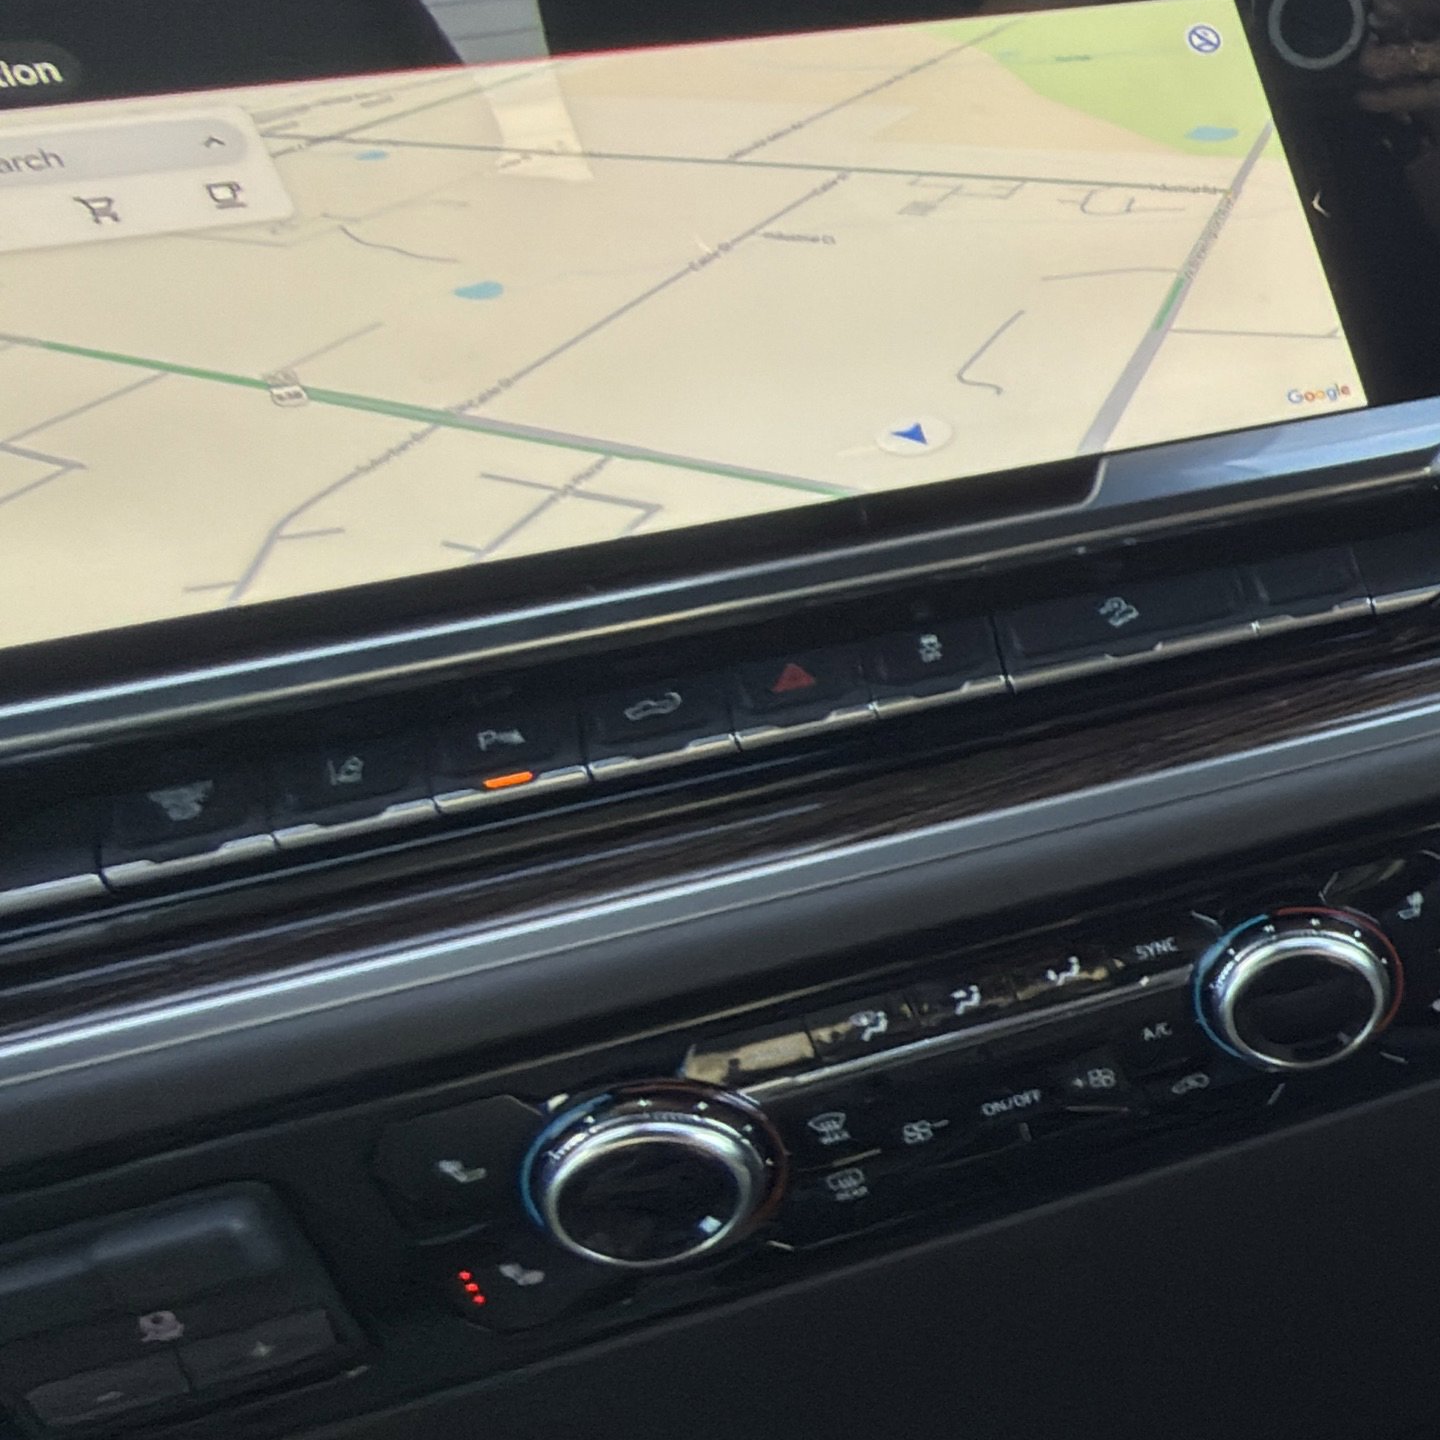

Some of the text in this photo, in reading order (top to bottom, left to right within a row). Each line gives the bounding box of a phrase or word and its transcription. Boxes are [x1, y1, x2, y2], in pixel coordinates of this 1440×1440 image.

[1286, 383, 1351, 406] Google
[1135, 936, 1179, 961] SYNC
[1141, 1021, 1173, 1042] A/C
[980, 1087, 1043, 1117] ON/OFF
